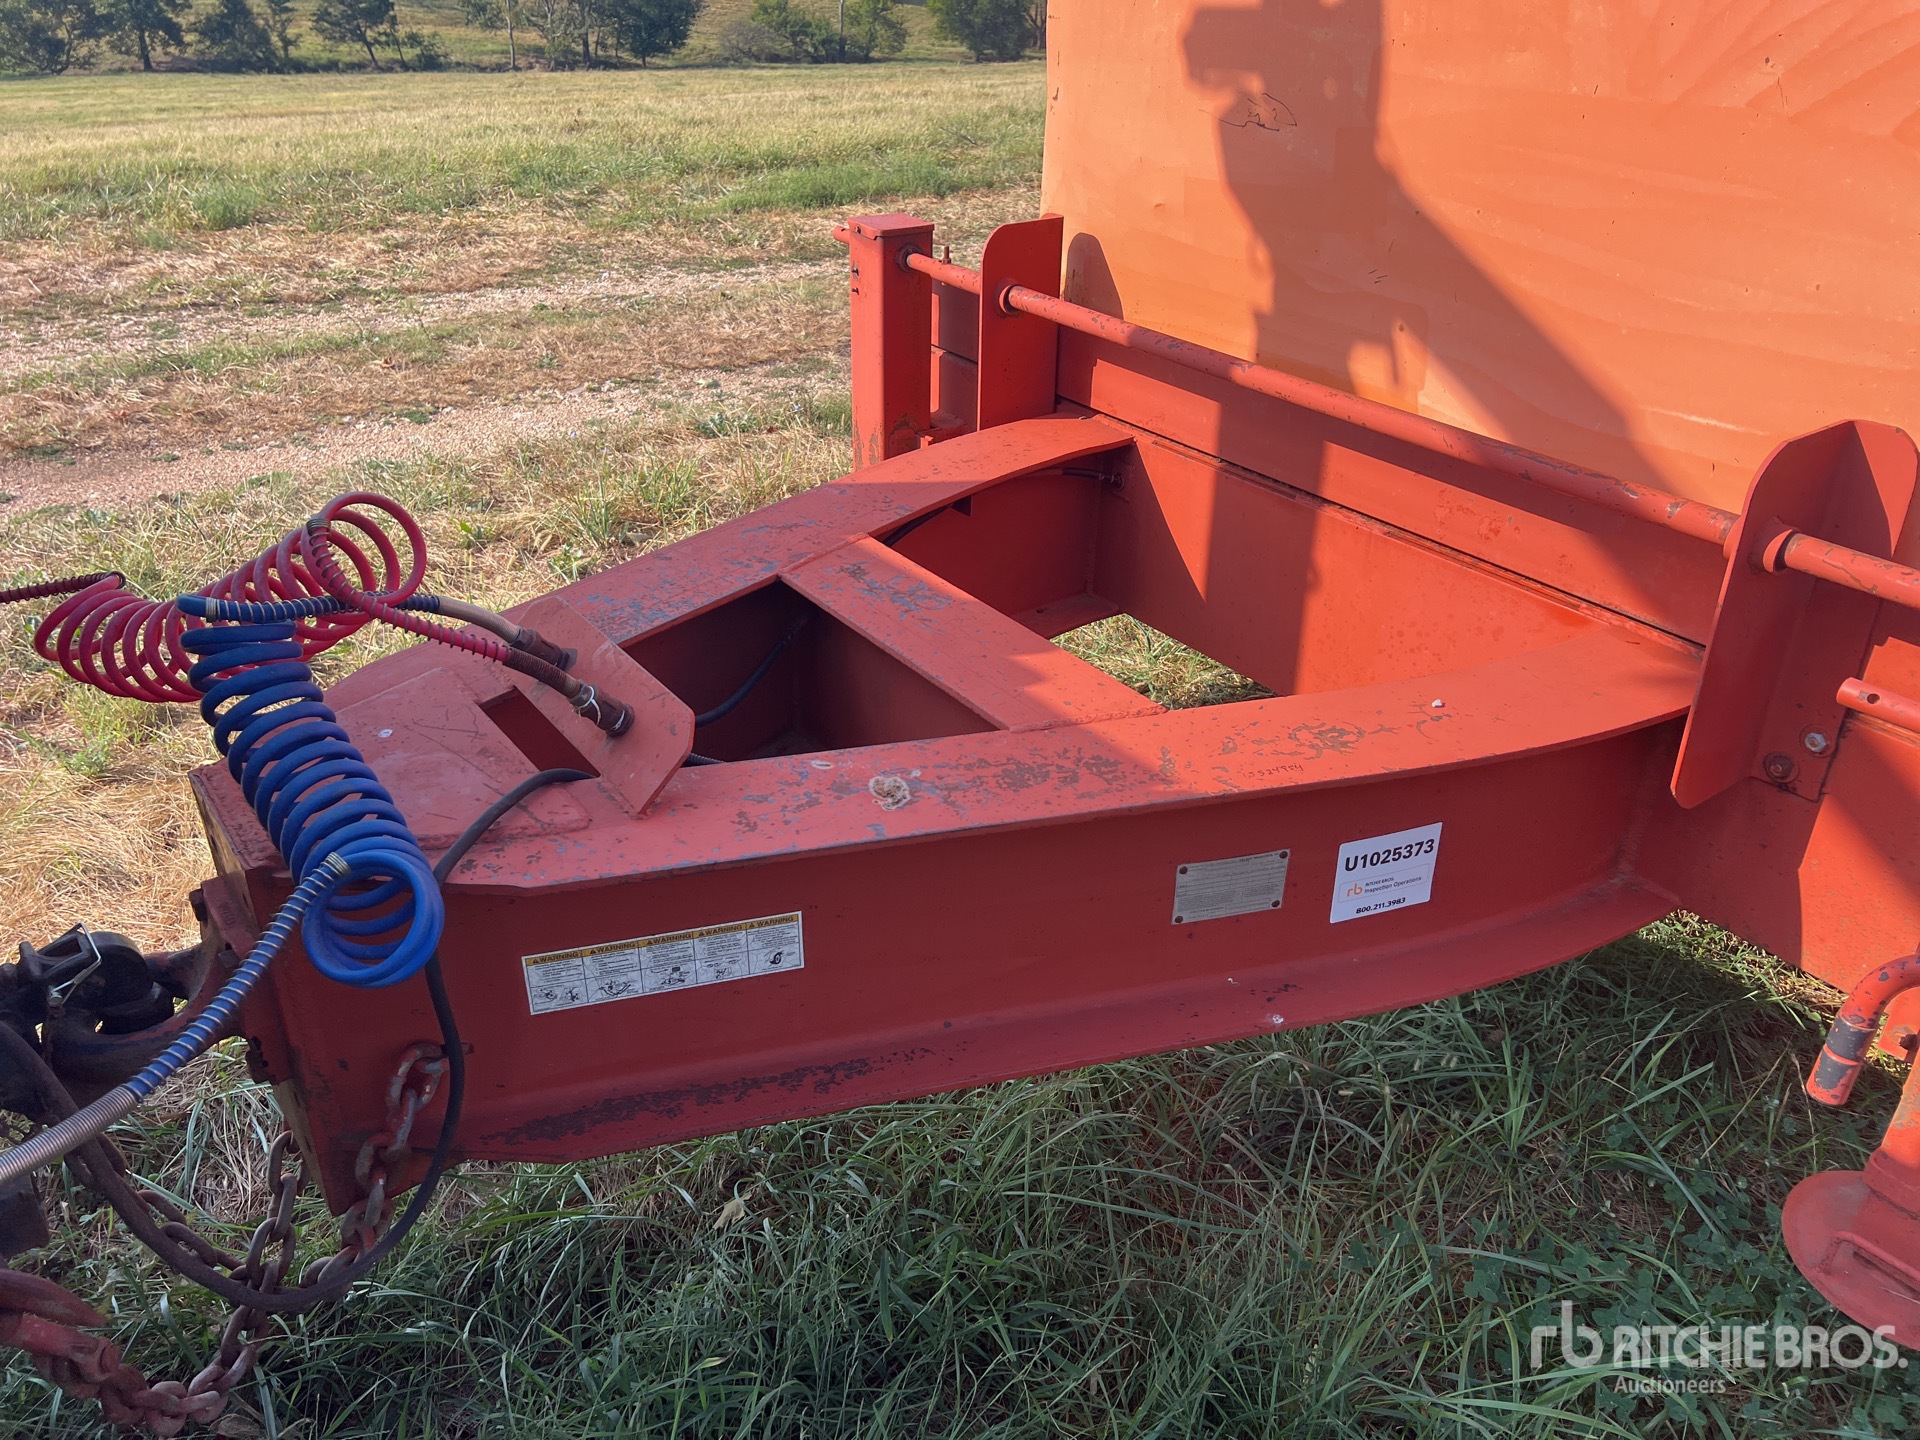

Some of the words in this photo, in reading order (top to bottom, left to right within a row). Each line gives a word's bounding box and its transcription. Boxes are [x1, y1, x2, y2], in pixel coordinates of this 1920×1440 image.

[1345, 838, 1435, 872] U1025373
[1347, 883, 1363, 897] rb
[1364, 883, 1393, 894] Inspection
[1393, 876, 1422, 888] Operations
[1356, 897, 1406, 914] 800.211.3983
[757, 916, 794, 927] WARNING
[705, 924, 743, 935] WARNING
[652, 933, 691, 944] WARNING
[597, 942, 635, 953] WARNING
[539, 951, 578, 963] WARNING
